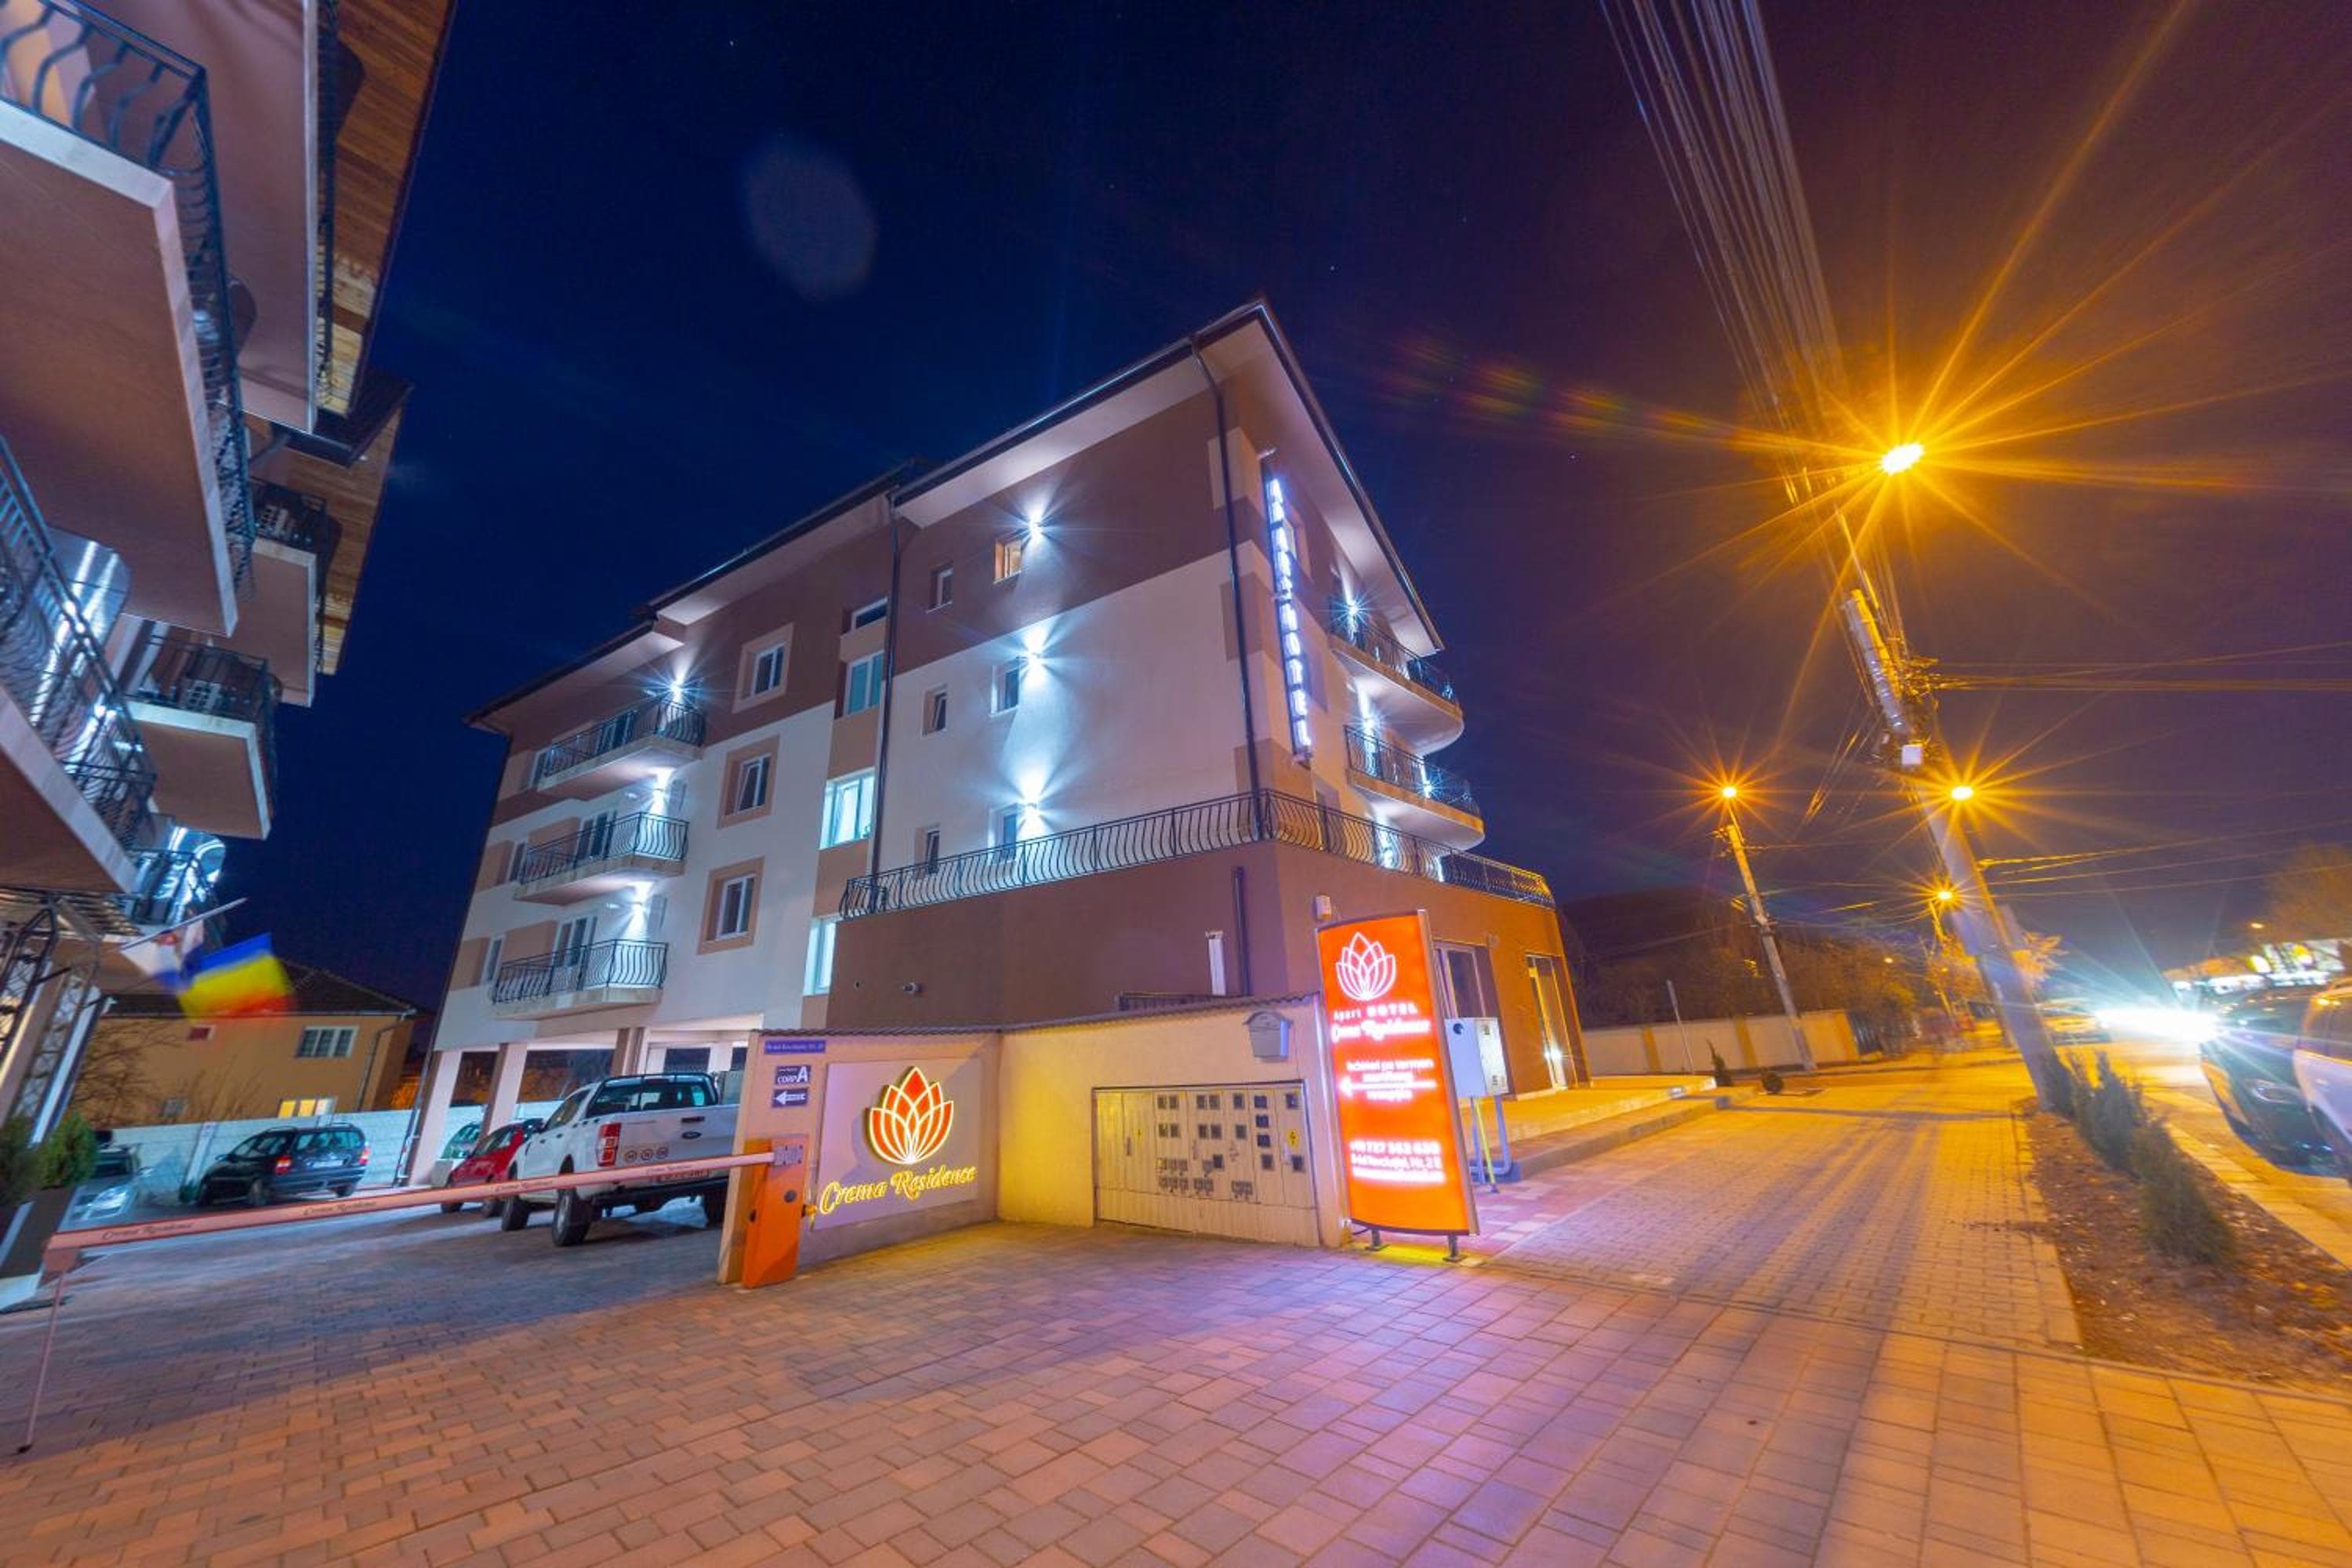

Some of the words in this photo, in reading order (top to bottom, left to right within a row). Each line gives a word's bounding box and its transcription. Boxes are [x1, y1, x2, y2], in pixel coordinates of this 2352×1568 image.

[796, 1065, 808, 1083] A
[820, 1181, 887, 1214] Crema
[891, 1165, 977, 1201] Residence
